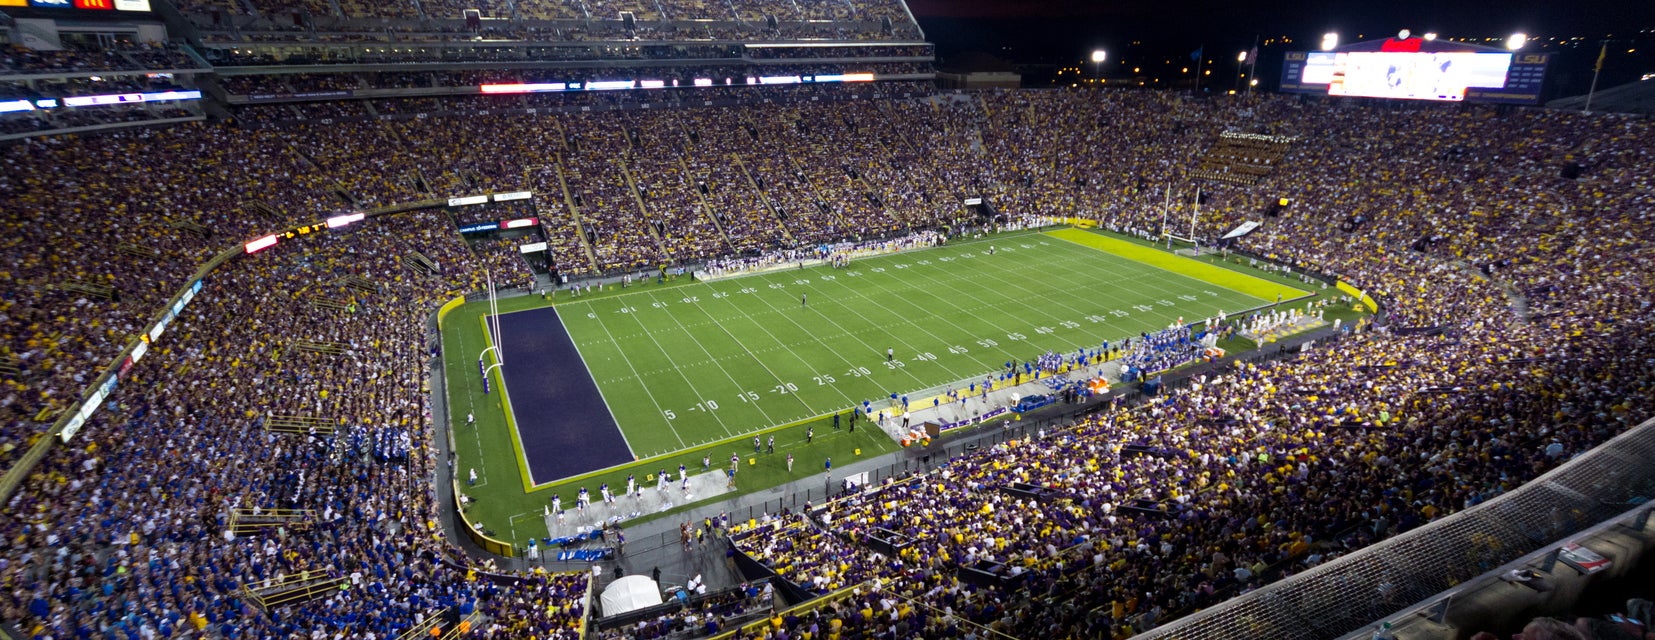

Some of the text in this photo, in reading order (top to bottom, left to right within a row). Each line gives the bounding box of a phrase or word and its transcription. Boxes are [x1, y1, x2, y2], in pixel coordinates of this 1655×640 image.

[1286, 53, 1306, 61] LSU
[1515, 55, 1547, 64] LSU
[620, 306, 637, 314] 10
[1059, 320, 1080, 329] 35
[1034, 326, 1054, 335] 40
[1007, 332, 1027, 341] 45
[976, 338, 999, 348] 50
[948, 345, 969, 355] 45
[916, 352, 938, 362] 40
[883, 359, 905, 370] 35
[849, 367, 872, 377] 30
[813, 374, 836, 386] 25
[775, 382, 799, 394] 20
[737, 391, 760, 403] 15
[696, 400, 719, 412] 10
[664, 409, 676, 420] 5
